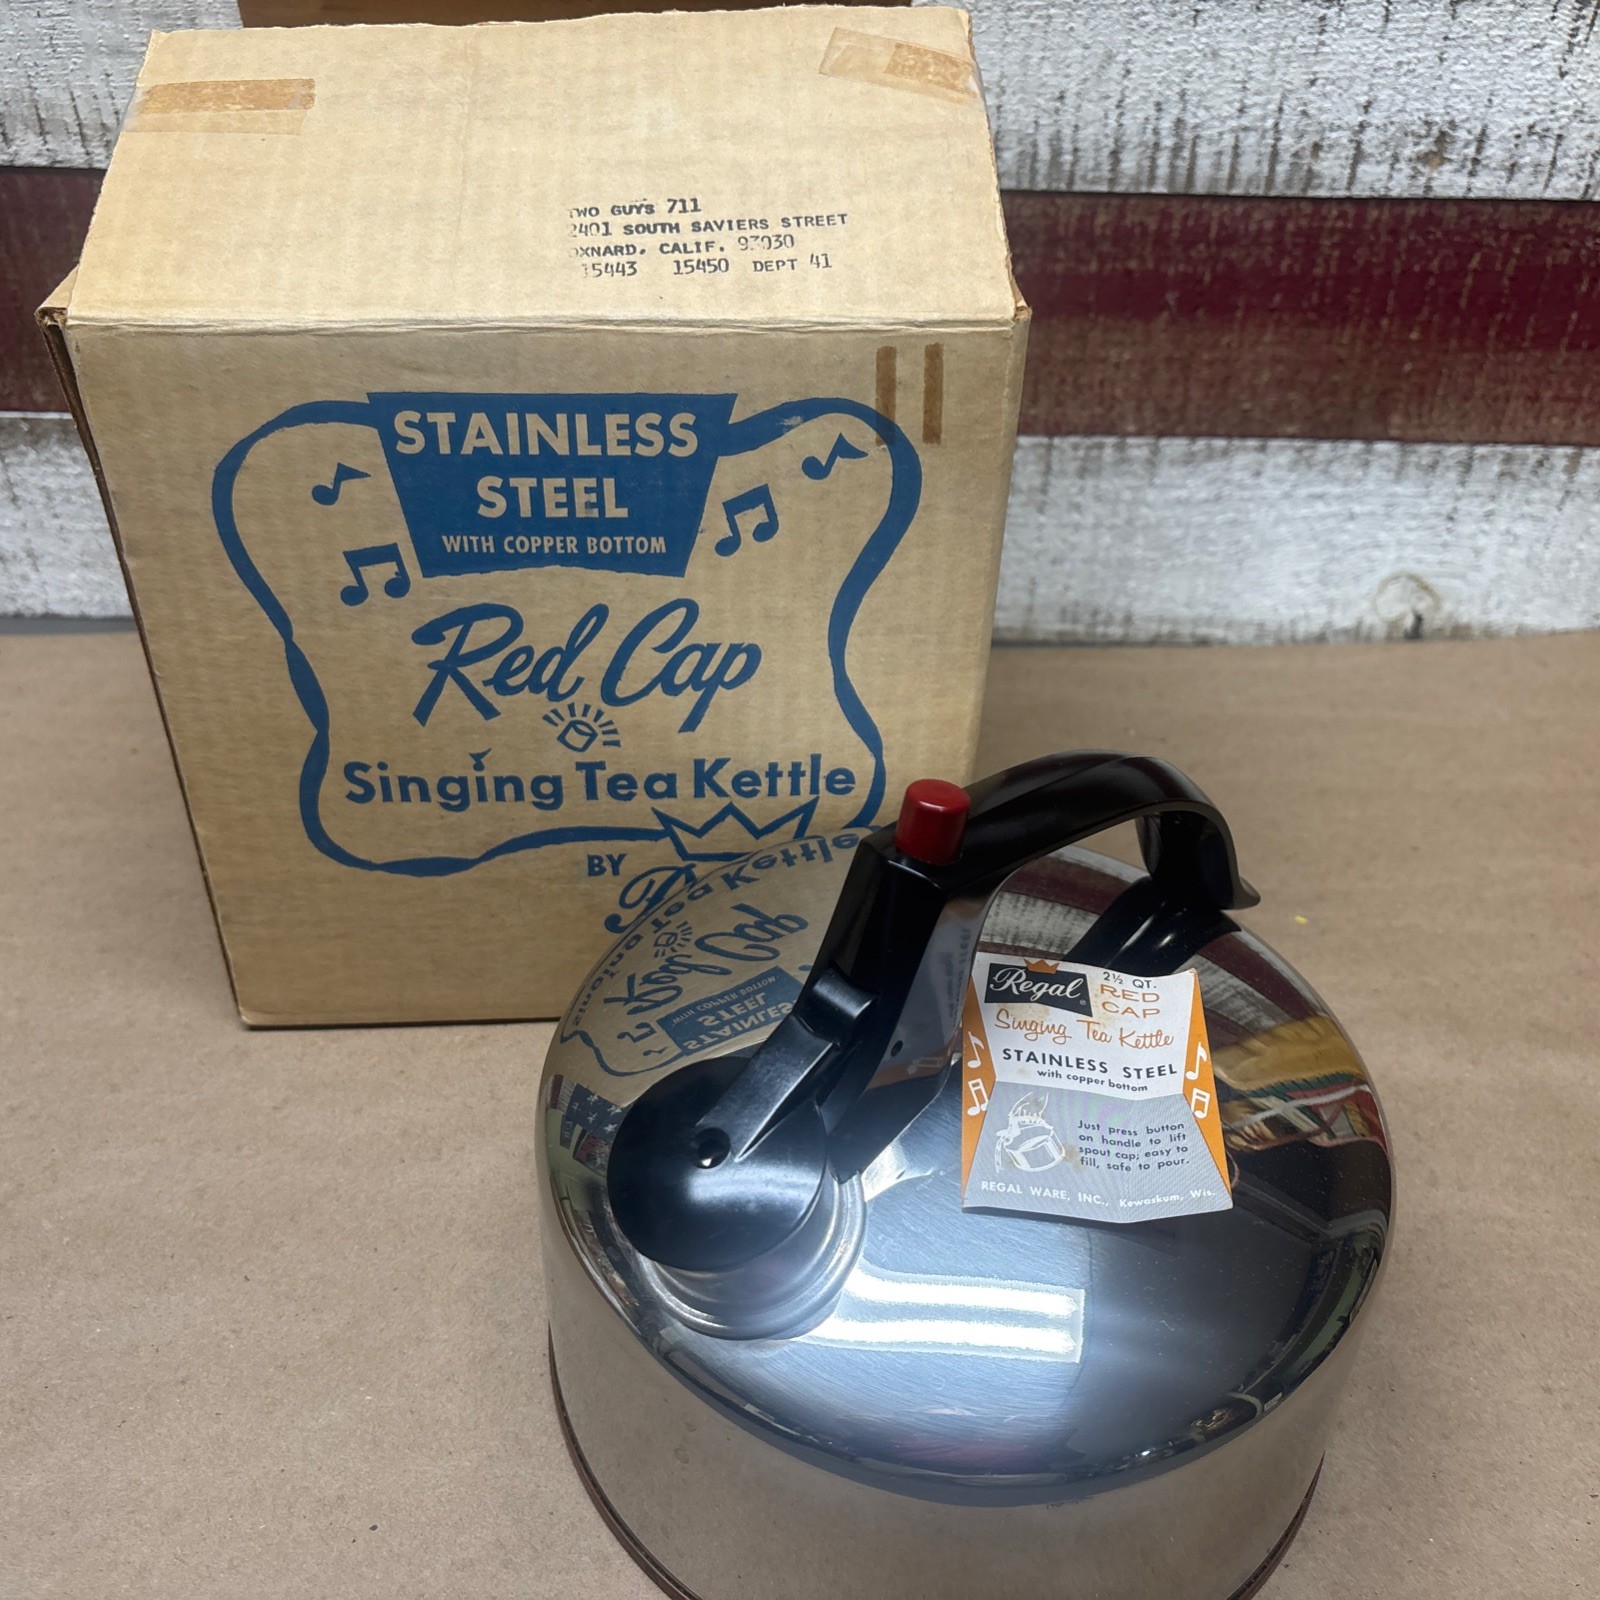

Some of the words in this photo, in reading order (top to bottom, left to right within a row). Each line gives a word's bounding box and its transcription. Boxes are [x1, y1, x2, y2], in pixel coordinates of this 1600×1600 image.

[611, 203, 655, 216] GUYS
[667, 198, 702, 214] 711
[623, 222, 681, 235] SOUTH
[691, 218, 769, 233] SAVIERS
[781, 213, 848, 228] STREET
[659, 241, 725, 254] CALIF.
[674, 258, 729, 275] 15450
[752, 258, 798, 272] DEPT
[810, 253, 832, 269] 41
[394, 410, 698, 457] STAINLESS
[476, 475, 629, 519] STEEL
[442, 535, 495, 553] WITH
[504, 535, 578, 554] COPPER
[587, 536, 667, 554] BOTTOM
[411, 602, 609, 727] Red
[600, 597, 763, 733] Cap
[343, 749, 564, 812] Singing
[575, 760, 678, 802] Tea
[692, 753, 856, 799] Kettle
[587, 853, 627, 877] BY
[989, 967, 1084, 1001] Regal
[1099, 983, 1161, 1003] RED
[1132, 978, 1157, 989] QT.
[1101, 1001, 1161, 1019] CAP
[994, 1008, 1072, 1045] Singing
[1076, 1018, 1112, 1043] Tea
[1118, 1028, 1174, 1049] Kettle
[1003, 1048, 1109, 1074] STAINLESS
[1122, 1063, 1178, 1080] STEEL
[1037, 1068, 1062, 1080] with
[1066, 1073, 1105, 1087] copper
[1108, 1078, 1148, 1092] bottom
[1077, 1119, 1101, 1131] Just
[1108, 1126, 1138, 1136] press
[1146, 1122, 1185, 1135] button
[1078, 1134, 1094, 1142] on
[1101, 1135, 1141, 1148] handle
[1149, 1137, 1161, 1145] to
[1169, 1132, 1187, 1143] lift
[1078, 1146, 1111, 1156] spout
[1115, 1151, 1140, 1162] cap;
[1144, 1147, 1172, 1158] easy
[1176, 1145, 1189, 1153] to
[1079, 1156, 1100, 1169] fill,
[1106, 1162, 1132, 1172] safe
[1157, 1158, 1190, 1170] pour.
[981, 1180, 1023, 1195] REGAL
[1029, 1185, 1071, 1202] WARE,
[1078, 1191, 1109, 1207] INC.,
[1119, 1192, 1185, 1208] Kewaskum,
[1189, 1187, 1216, 1199] Wis.
